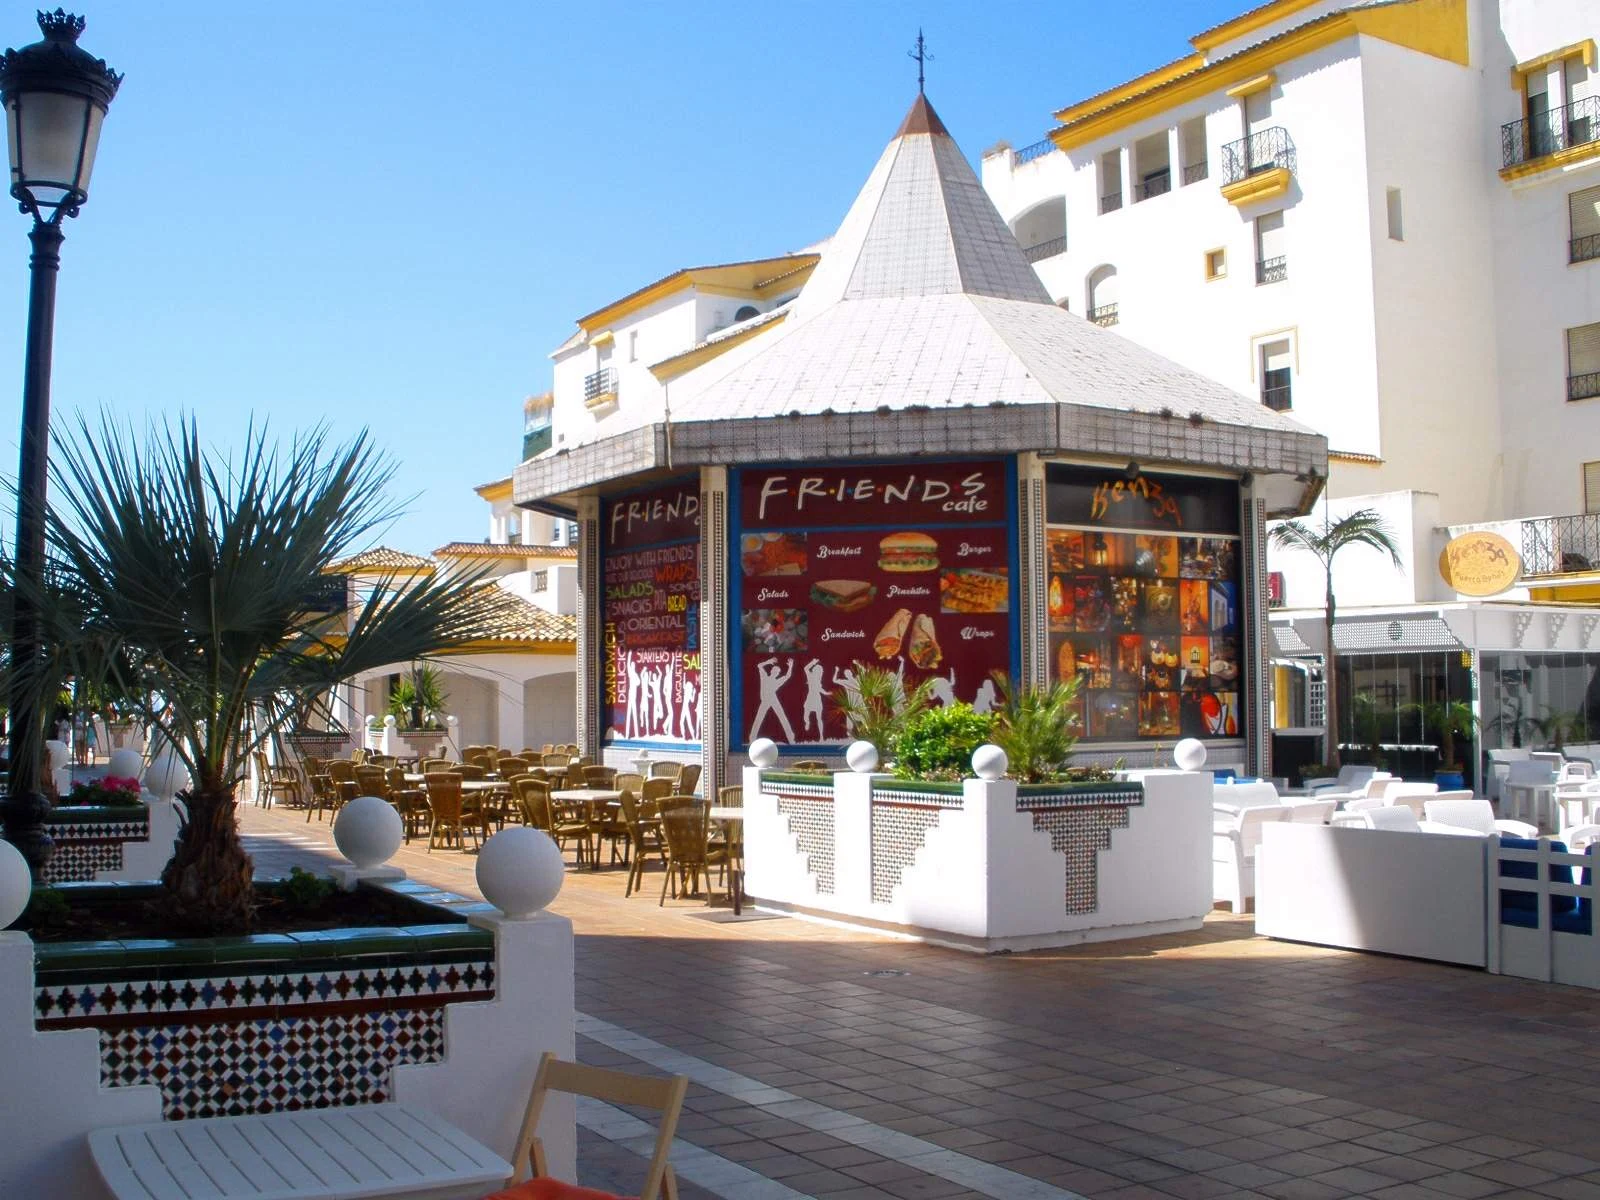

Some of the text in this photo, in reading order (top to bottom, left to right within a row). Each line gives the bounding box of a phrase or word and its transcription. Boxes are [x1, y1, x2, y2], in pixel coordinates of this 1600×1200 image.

[942, 495, 989, 513] cafe
[611, 492, 699, 545] FRIEND
[635, 551, 657, 567] WITH
[657, 545, 694, 563] FRIENDS
[816, 545, 862, 559] Breakfast
[957, 543, 992, 557] Burger
[656, 562, 696, 583] WRAPS
[606, 581, 654, 599] SALADS
[757, 588, 789, 602] Salads
[886, 585, 931, 599] Pinchitos
[611, 598, 652, 616] SNACKS
[627, 615, 686, 631] ORIENTAL
[627, 630, 686, 646] BREAKFAST
[821, 628, 867, 642] Sandwich
[960, 626, 995, 640] Wraps
[605, 622, 616, 704] SANDWICH
[617, 621, 627, 703] DELICIOUS
[636, 647, 670, 664] STARTERS
[683, 652, 701, 670] SAL
